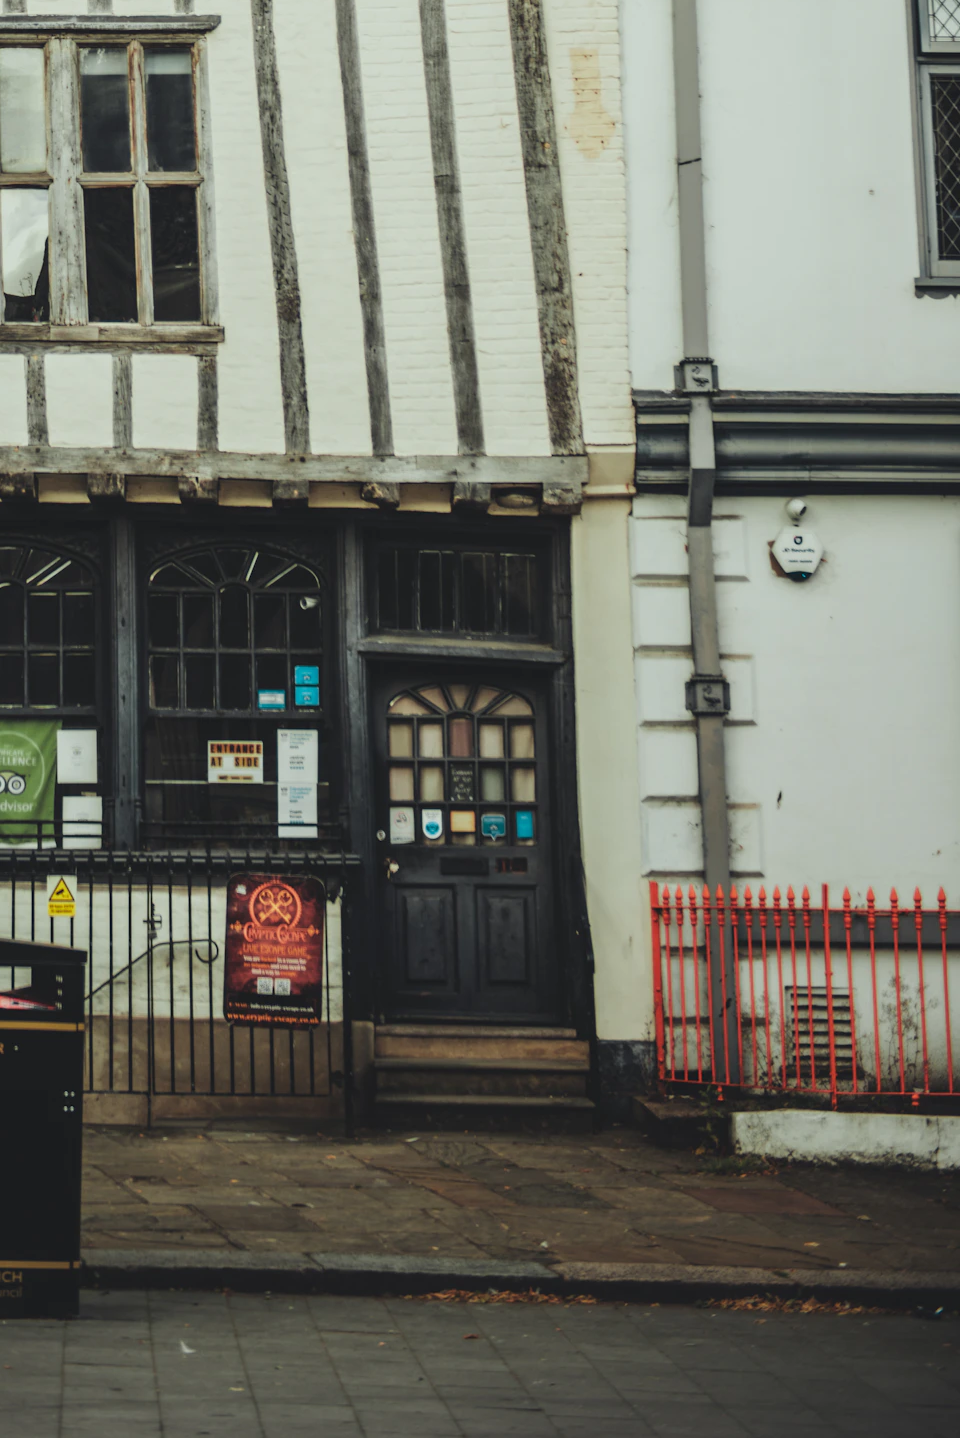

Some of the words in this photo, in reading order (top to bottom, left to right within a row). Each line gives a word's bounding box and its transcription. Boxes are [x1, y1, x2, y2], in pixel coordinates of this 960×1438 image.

[210, 743, 261, 754] ENTRANCE
[210, 756, 222, 767] AT
[234, 756, 259, 767] SIDE
